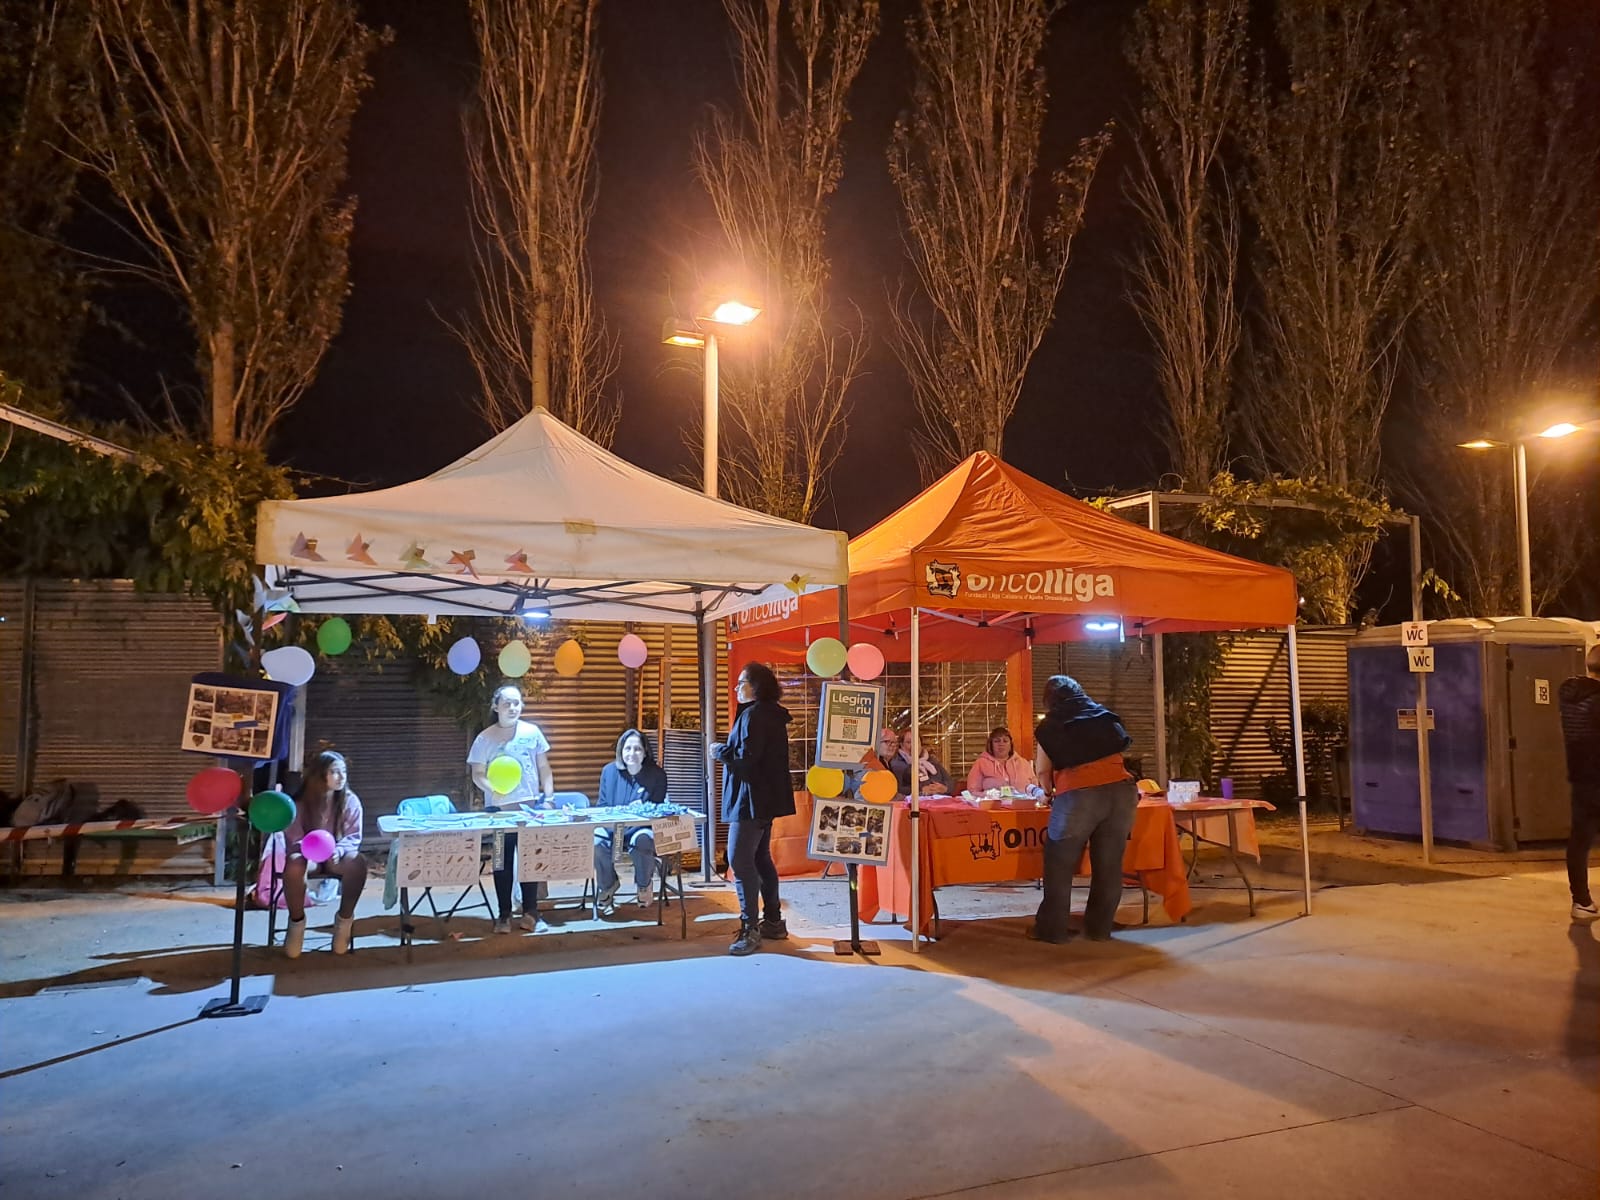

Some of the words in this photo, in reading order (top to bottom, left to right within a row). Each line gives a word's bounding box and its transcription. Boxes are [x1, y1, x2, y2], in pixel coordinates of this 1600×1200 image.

[966, 568, 1114, 602] oncolliga
[1406, 629, 1424, 641] WC
[1413, 655, 1431, 667] WC
[832, 692, 872, 706] Llegim
[856, 704, 871, 715] riu
